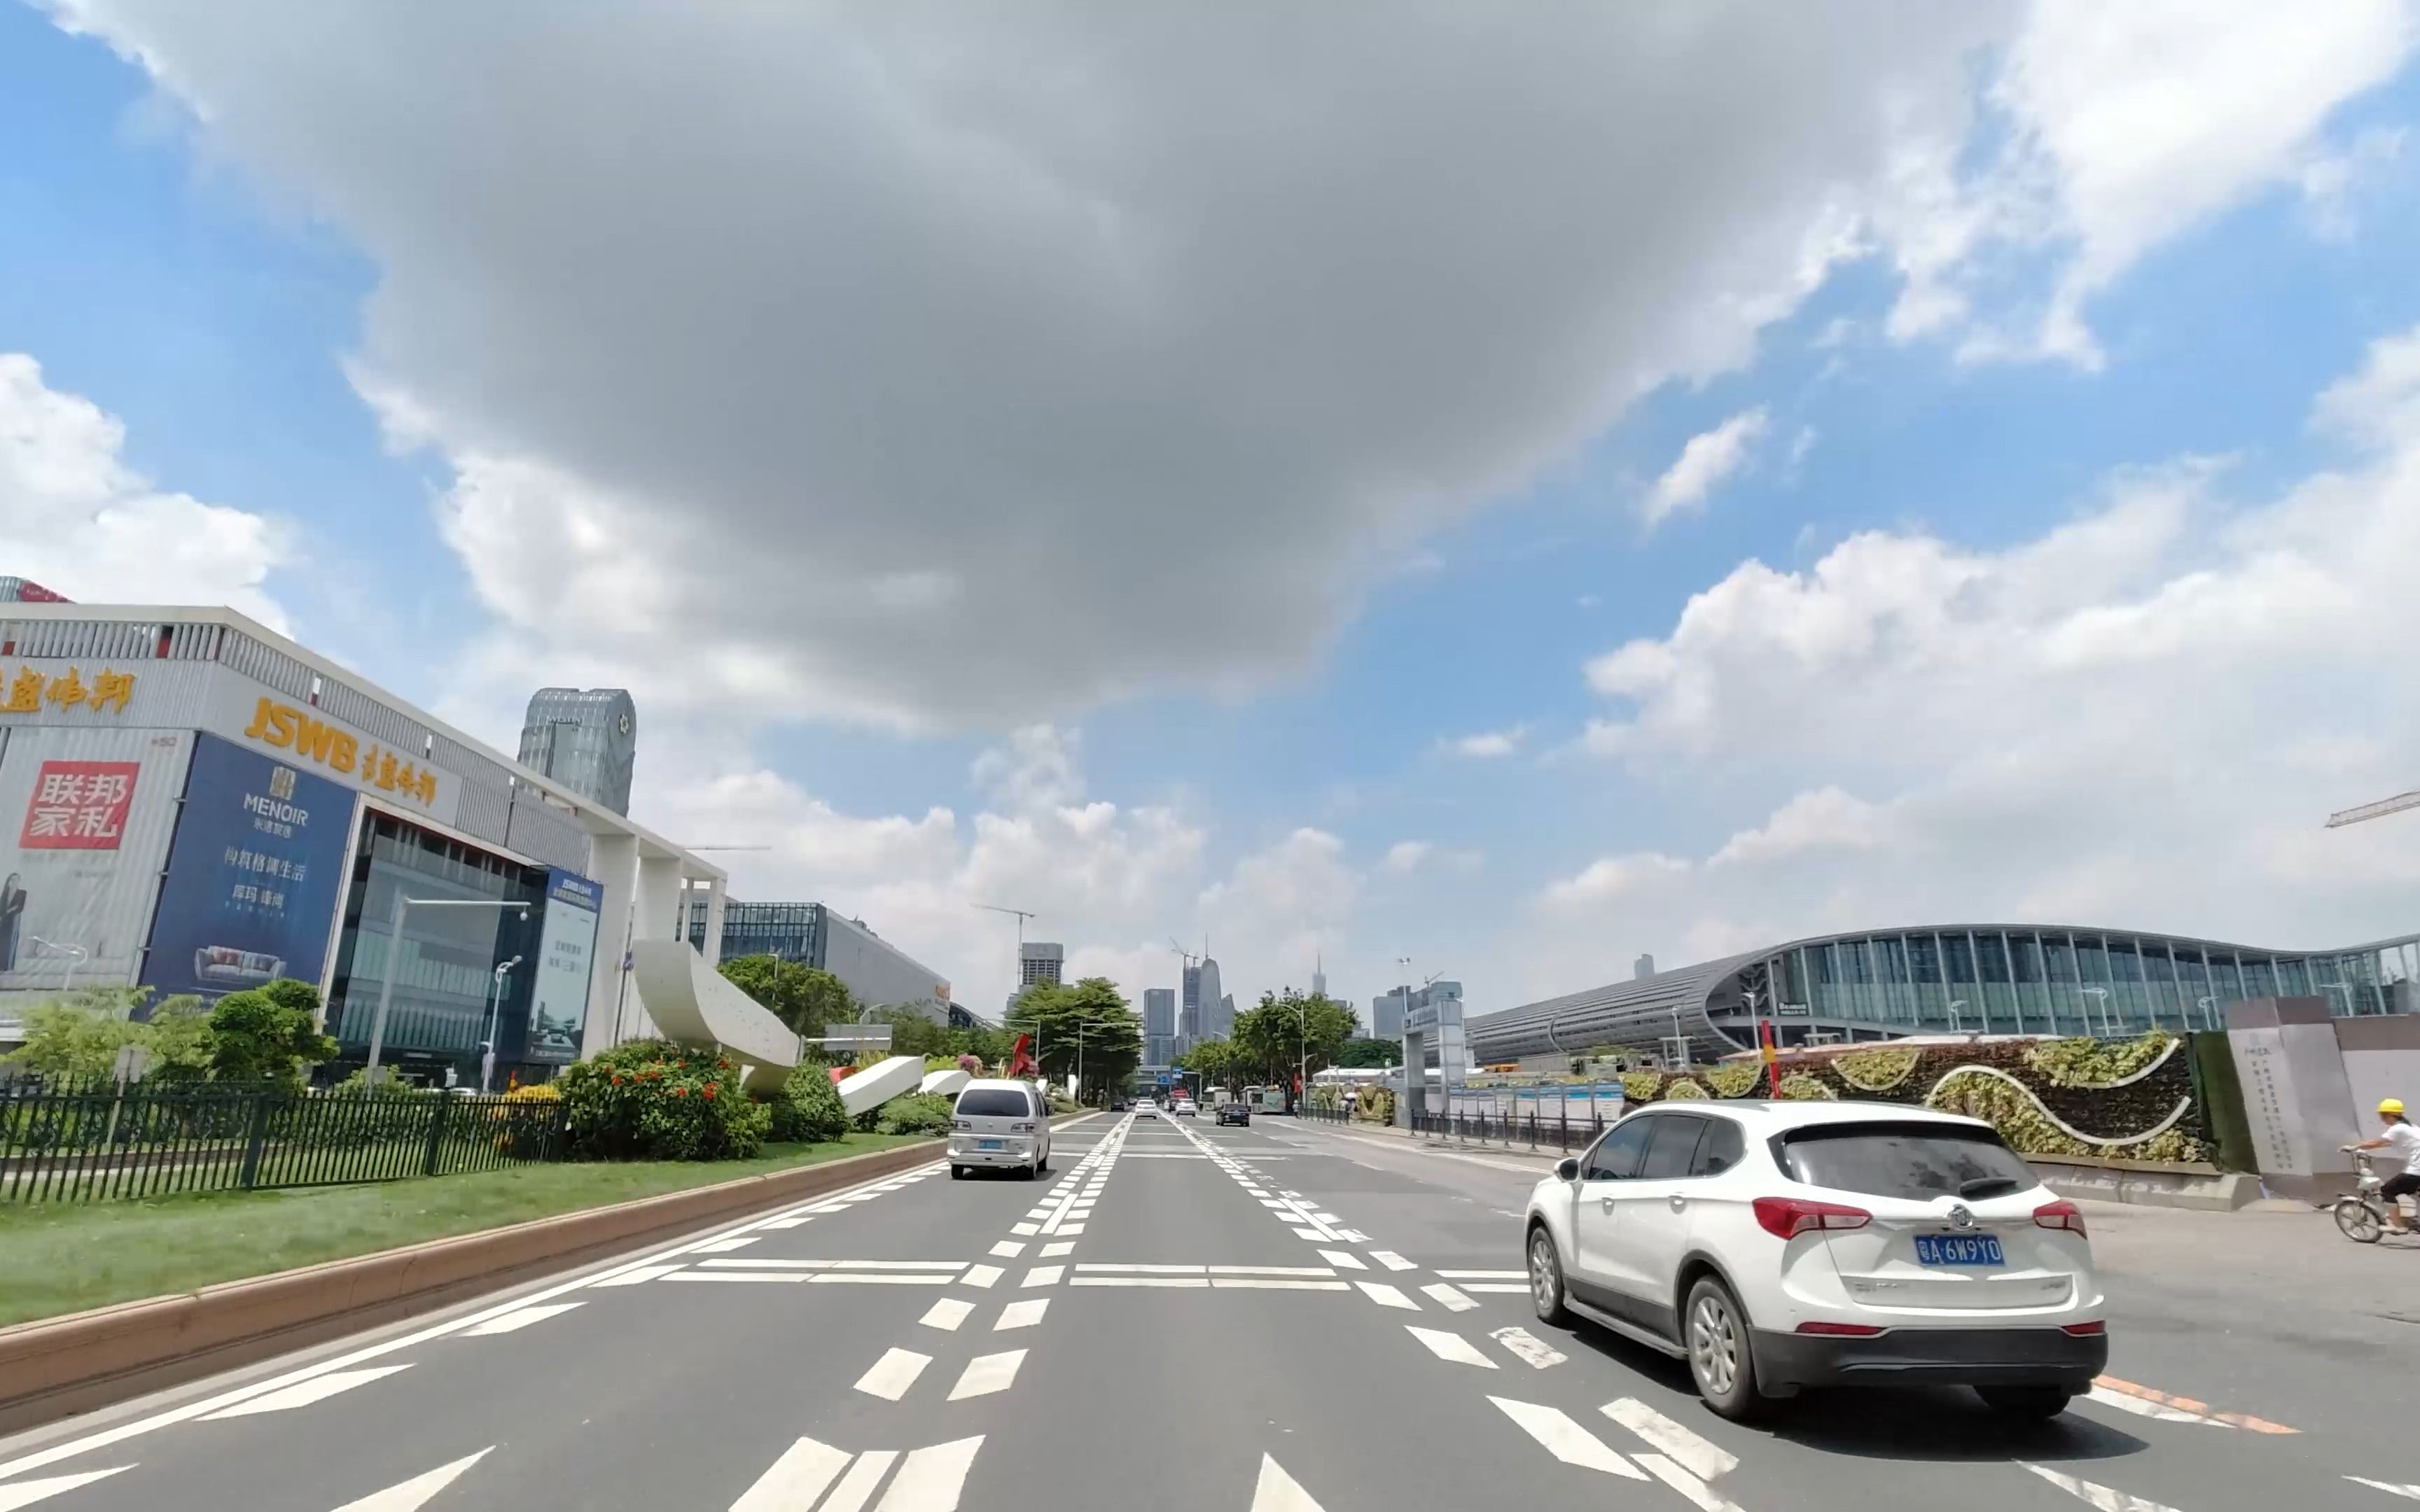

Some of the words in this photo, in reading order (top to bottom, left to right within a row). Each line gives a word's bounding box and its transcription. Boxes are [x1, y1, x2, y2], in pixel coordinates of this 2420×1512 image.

[0, 665, 137, 714] 盛伟邦
[244, 696, 358, 773] JSWB
[38, 774, 129, 804] 联邦
[29, 806, 119, 837] 家私
[244, 793, 309, 826] MENOIR
